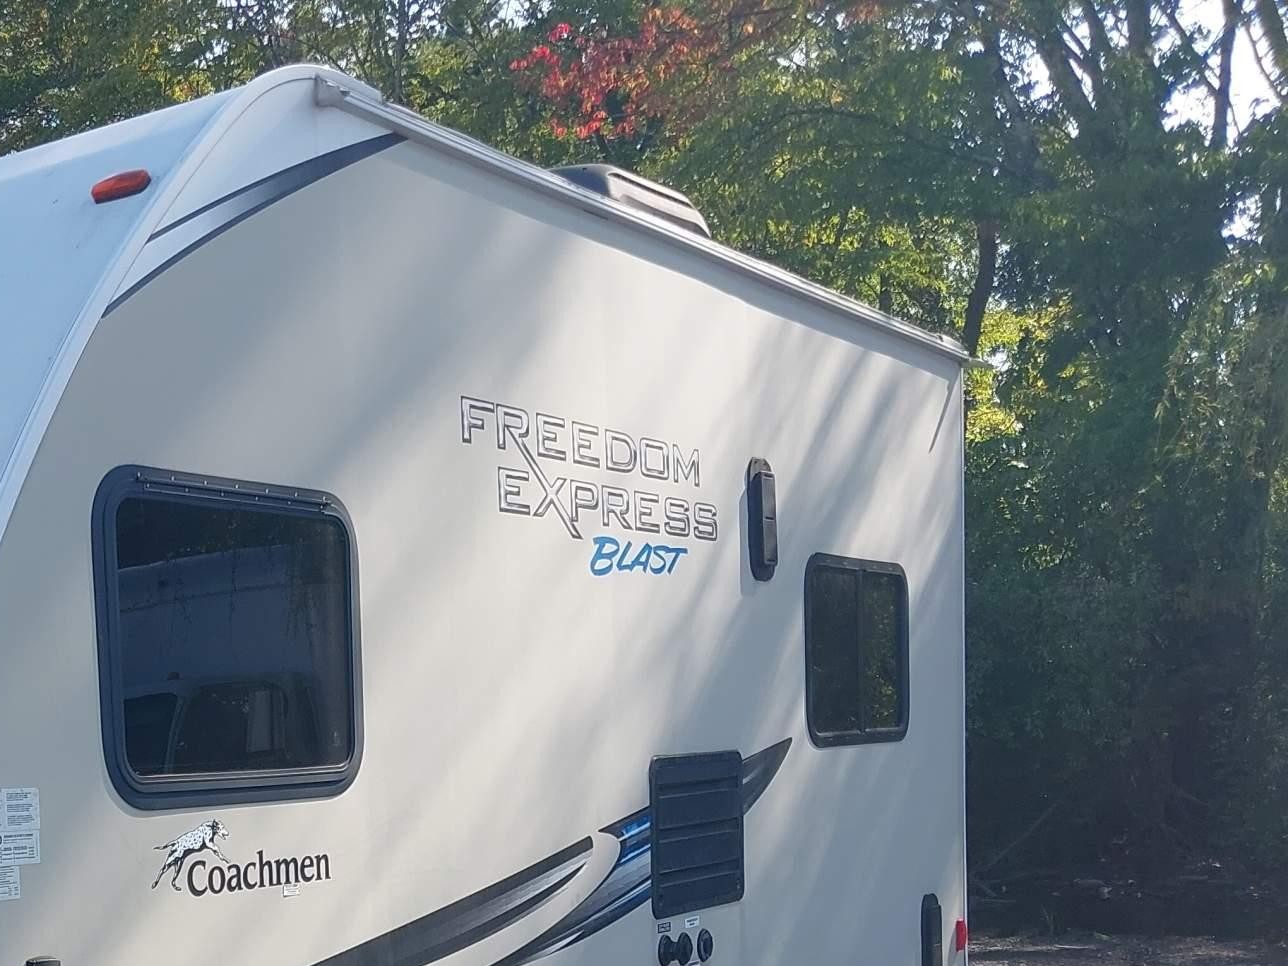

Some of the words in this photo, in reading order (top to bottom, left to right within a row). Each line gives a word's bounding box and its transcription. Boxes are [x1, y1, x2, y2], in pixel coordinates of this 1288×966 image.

[460, 395, 700, 488] FREEDOM
[497, 466, 718, 541] EXPRESS
[588, 536, 689, 577] BLAST
[187, 849, 331, 897] Coachmen
